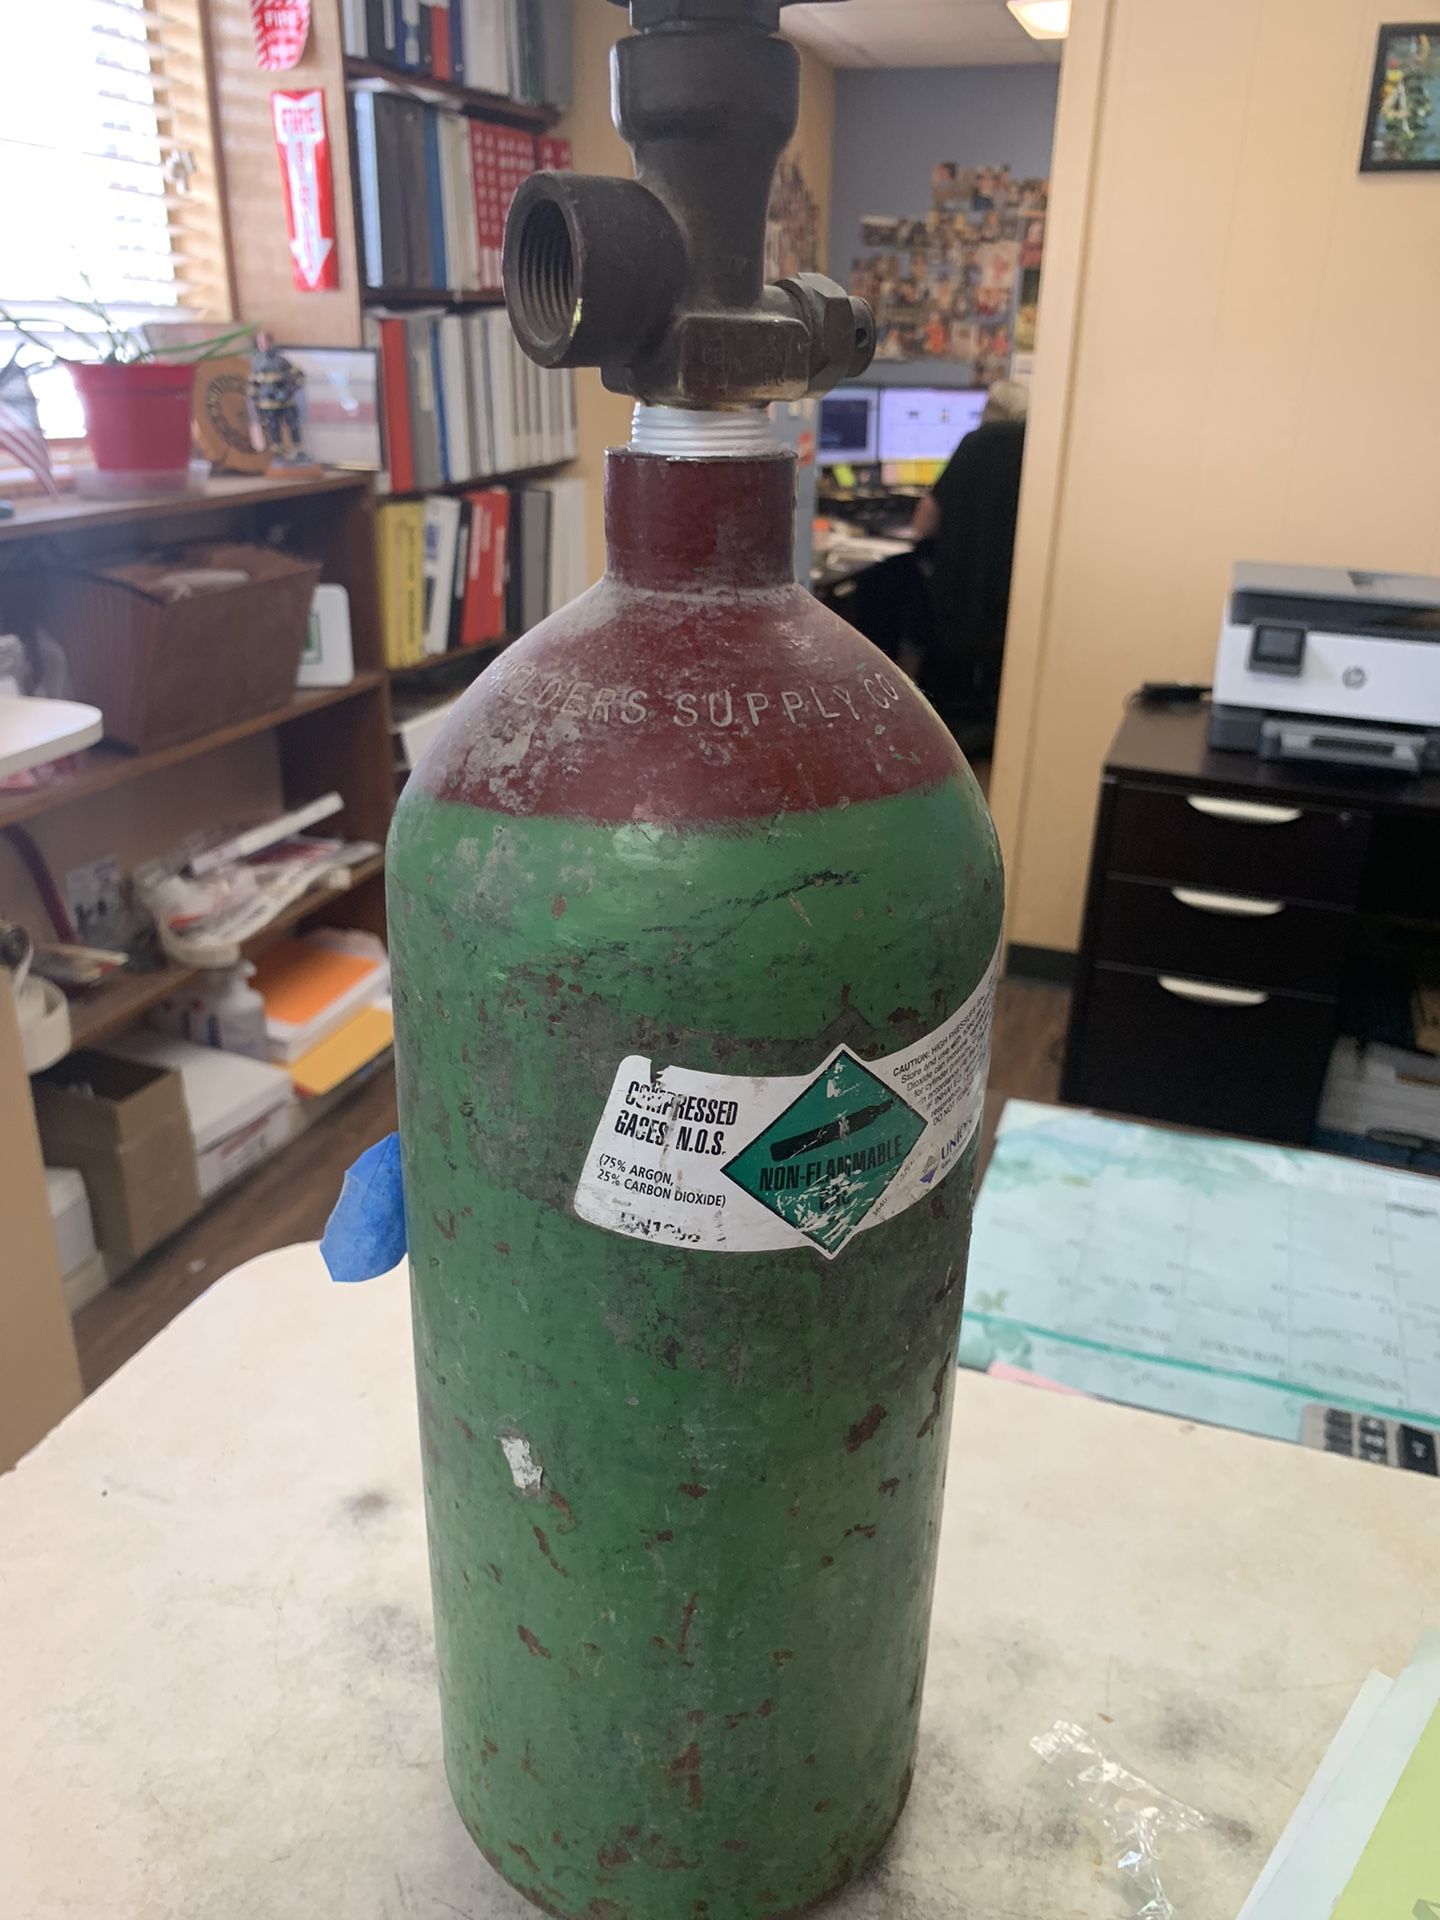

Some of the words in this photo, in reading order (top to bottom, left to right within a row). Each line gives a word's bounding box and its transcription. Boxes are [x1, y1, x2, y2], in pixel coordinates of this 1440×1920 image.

[673, 686, 861, 727] SUPPLY
[893, 1051, 931, 1077] CAUTION:
[901, 1068, 922, 1084] Store
[598, 1153, 626, 1173] (75%
[629, 1164, 674, 1187] ARGON,
[760, 1135, 902, 1191] NON-FLAMMABLE
[597, 1169, 620, 1186] 25%
[624, 1178, 671, 1200] CARBON
